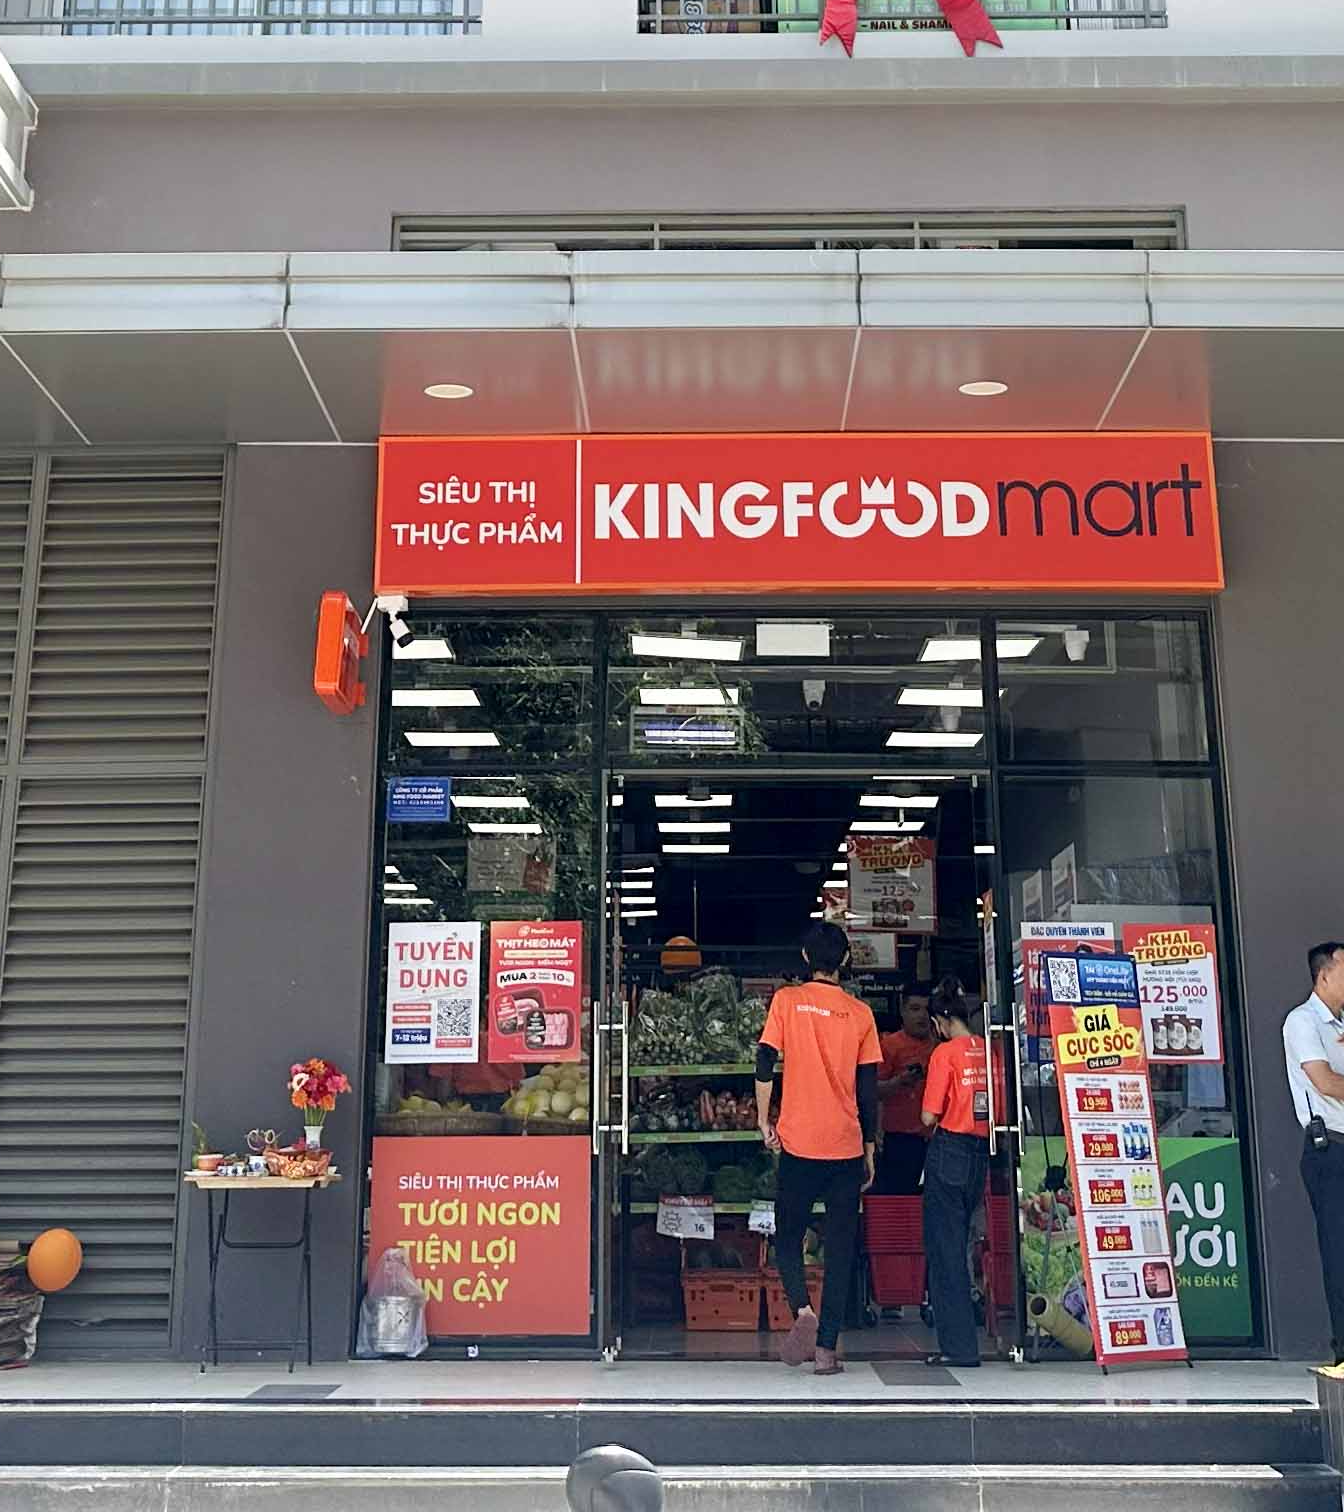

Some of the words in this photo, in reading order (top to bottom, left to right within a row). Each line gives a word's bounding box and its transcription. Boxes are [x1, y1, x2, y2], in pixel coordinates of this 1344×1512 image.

[869, 20, 898, 31] NAIL
[911, 19, 954, 30] SHAM
[418, 475, 481, 504] SIÊU
[488, 481, 536, 509] THỊ
[390, 519, 471, 551] THỰC
[478, 513, 563, 545] PHẨM
[394, 931, 474, 961] TUYỂN
[1149, 932, 1189, 947] KHAI
[399, 968, 468, 994] DỤNG
[499, 972, 528, 983] MUA
[1083, 1008, 1111, 1033] GIÁ
[1066, 1036, 1100, 1060] CỰC
[1103, 1026, 1134, 1052] SỐC
[398, 1171, 433, 1190] SIÊU
[436, 1175, 463, 1192] THỊ
[466, 1173, 510, 1192] THỰC
[397, 1198, 468, 1226] TƯƠI
[476, 1201, 561, 1226] NGON
[396, 1233, 462, 1272] TIỆN
[470, 1235, 517, 1271] LỢI
[452, 1270, 510, 1310] CẬY
